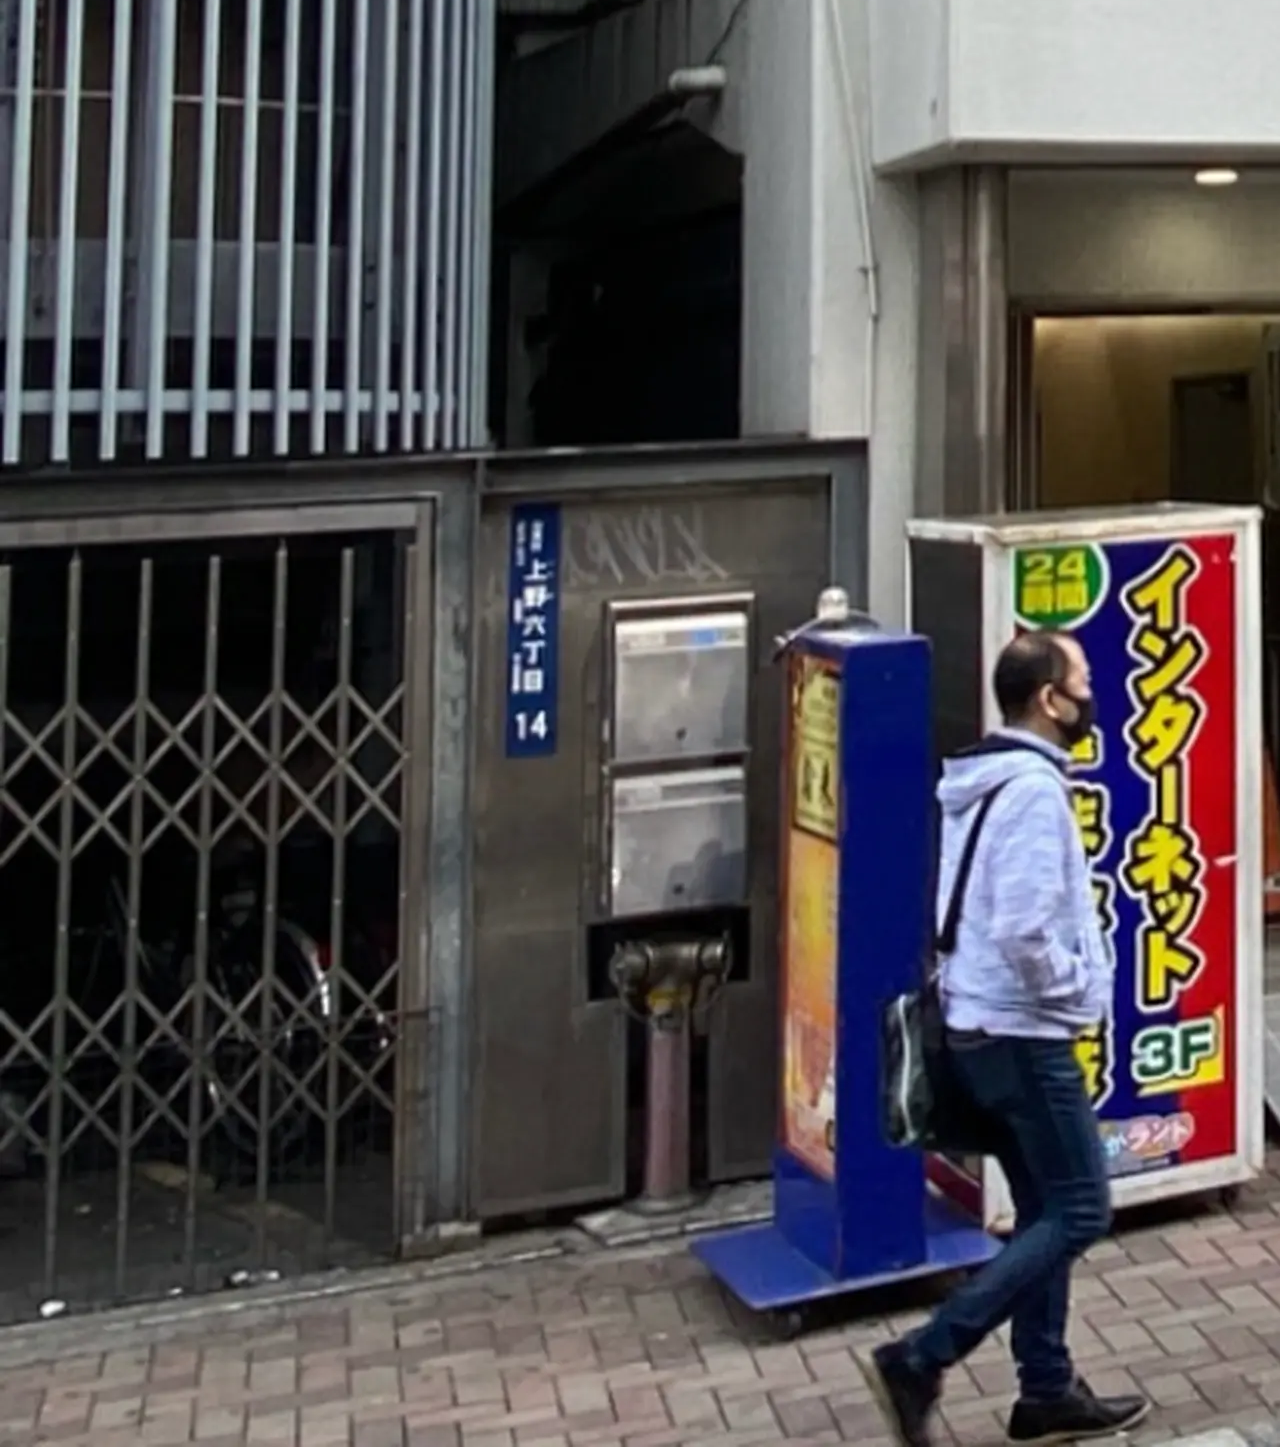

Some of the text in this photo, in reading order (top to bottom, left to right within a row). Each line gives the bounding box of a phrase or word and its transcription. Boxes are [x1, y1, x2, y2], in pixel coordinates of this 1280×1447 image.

[1023, 550, 1086, 582] 24
[515, 709, 549, 741] 14
[1130, 553, 1203, 1001] インターネット
[1134, 1018, 1214, 1080] 3F
